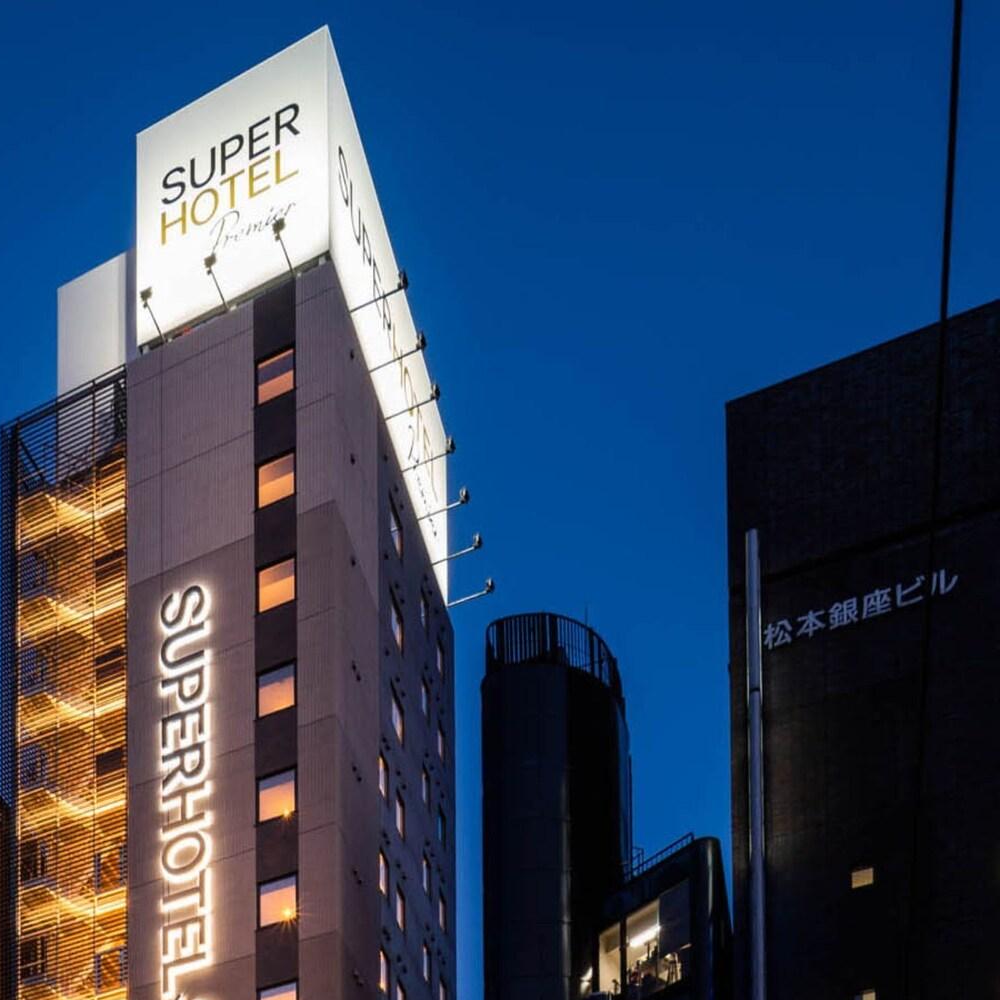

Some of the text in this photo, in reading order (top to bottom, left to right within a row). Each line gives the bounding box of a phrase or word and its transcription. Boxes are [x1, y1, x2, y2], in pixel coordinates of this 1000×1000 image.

[160, 149, 299, 246] HOTEL
[161, 103, 300, 205] SUPER
[764, 569, 959, 650] 松本銀座ビル
